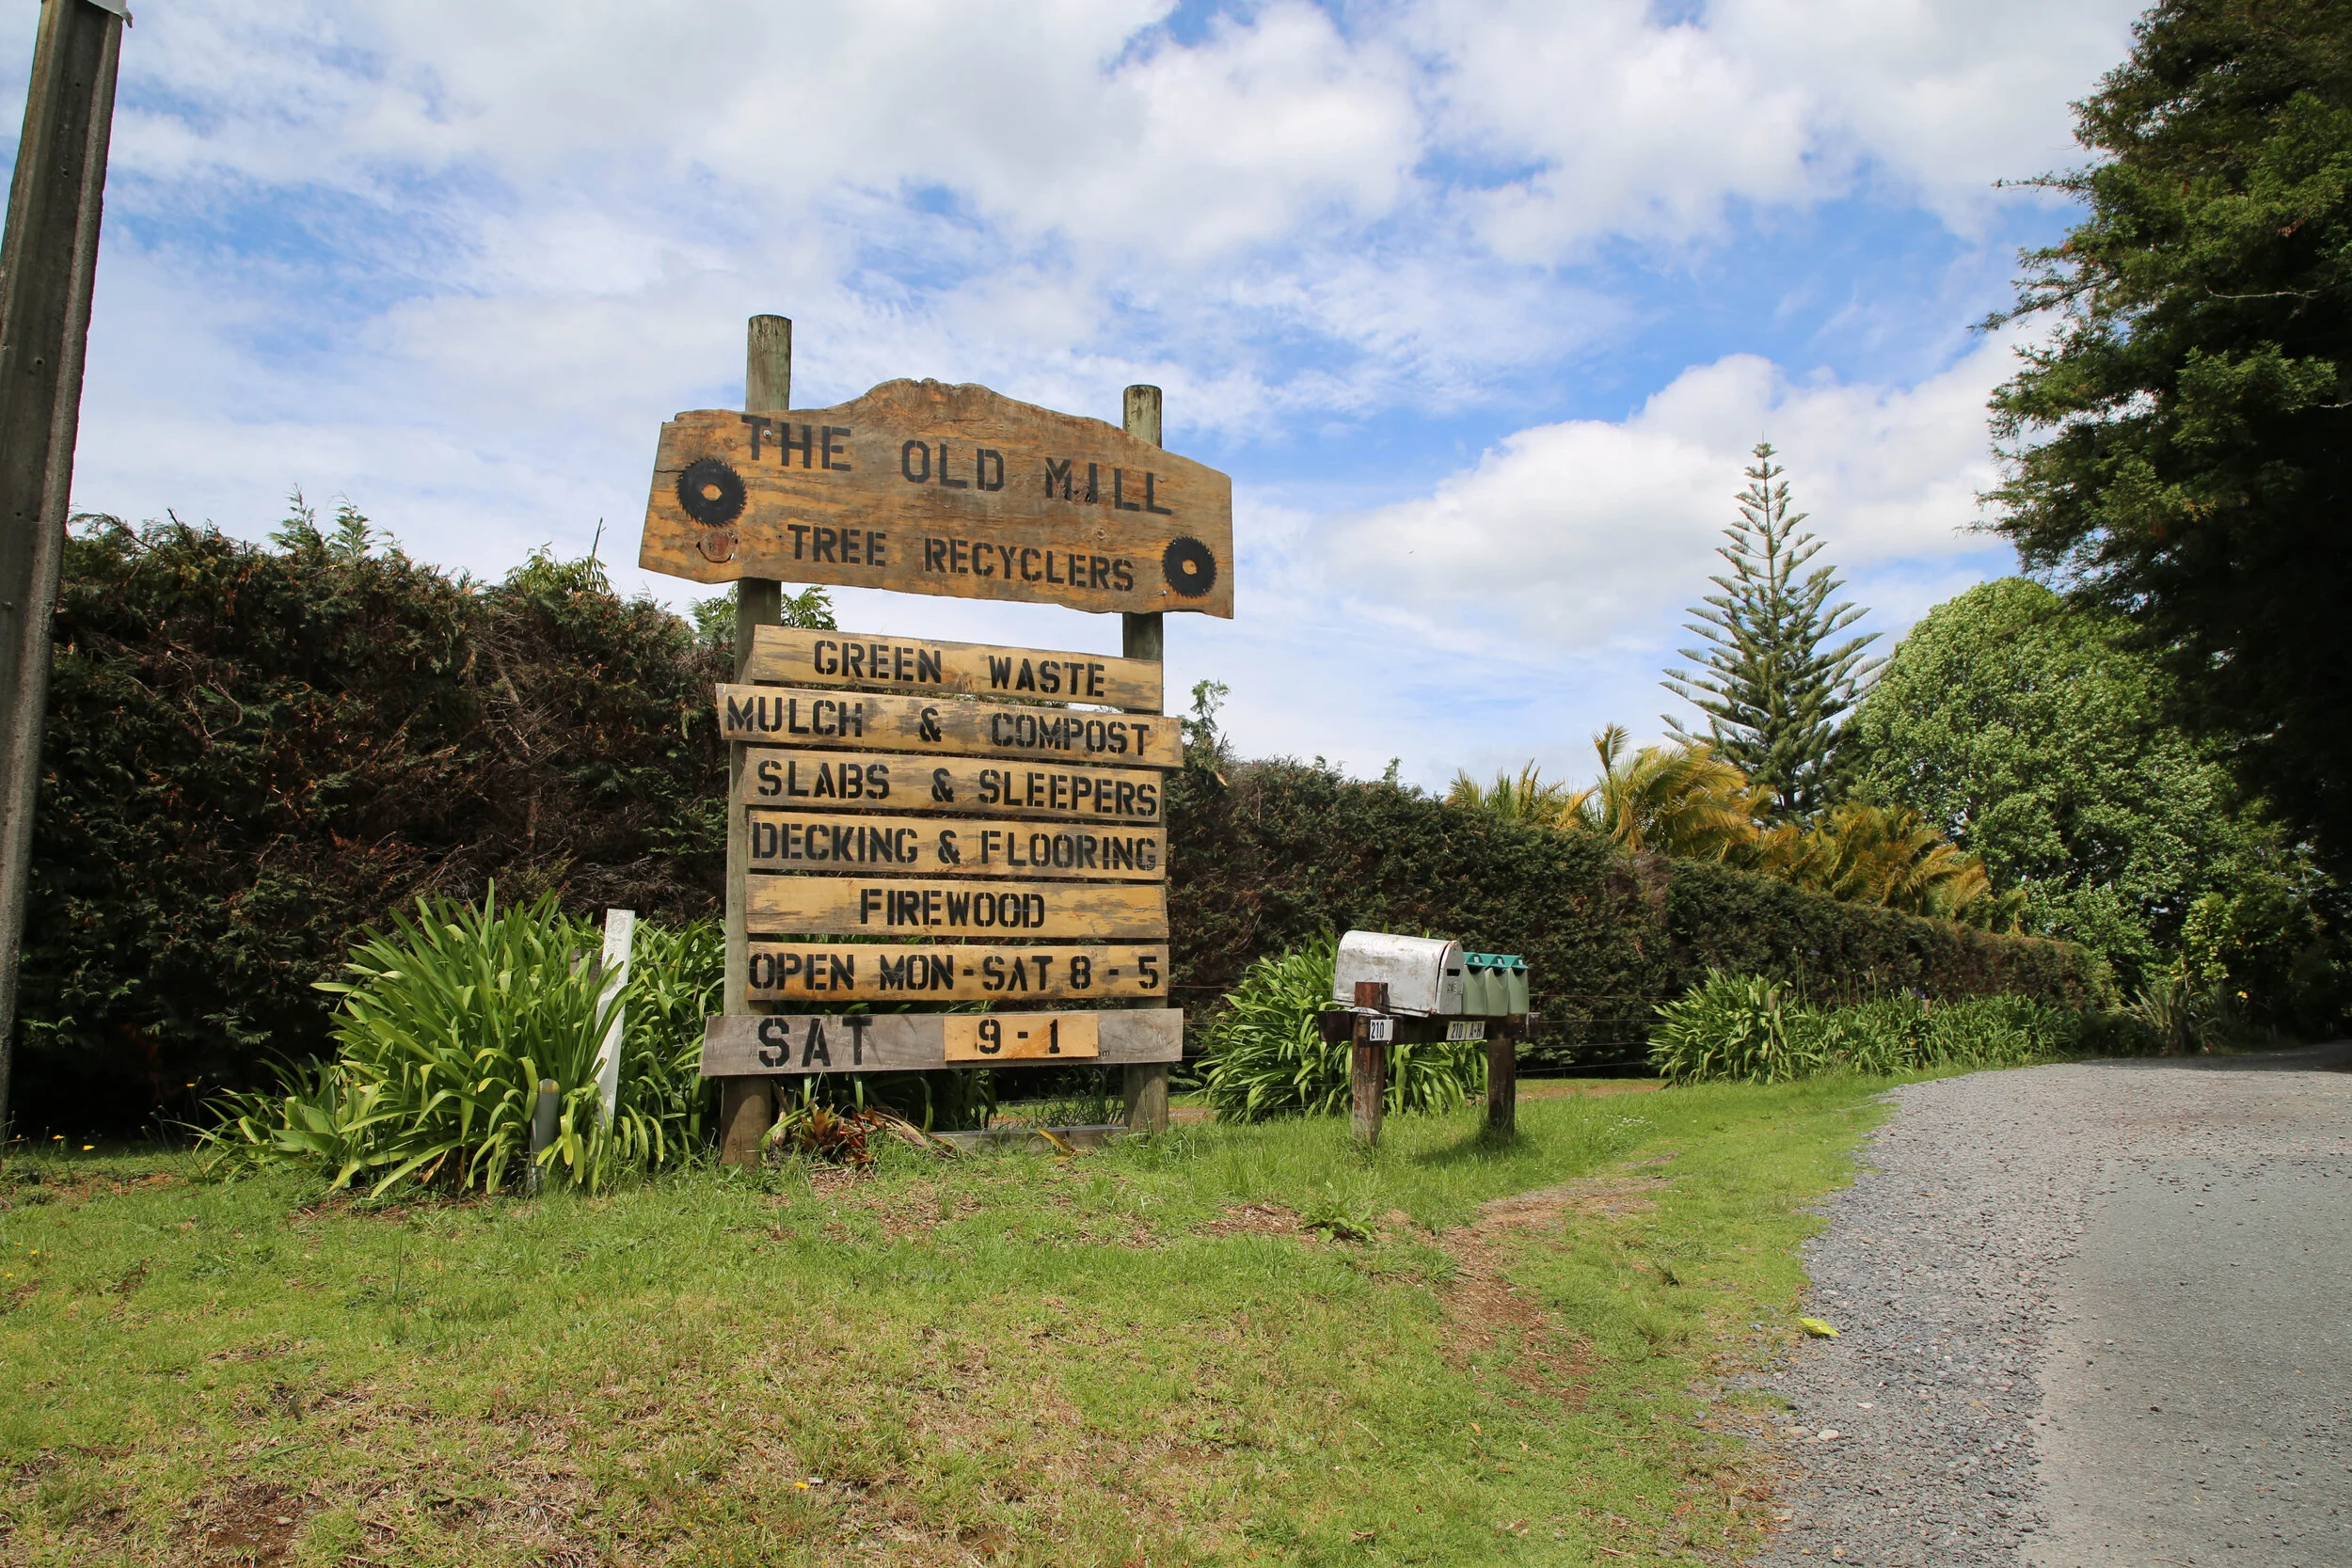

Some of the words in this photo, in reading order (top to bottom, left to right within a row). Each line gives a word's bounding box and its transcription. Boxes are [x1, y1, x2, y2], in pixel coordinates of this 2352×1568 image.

[740, 414, 851, 472] THE
[901, 439, 1005, 492] OLD
[1045, 457, 1172, 515] MILL
[787, 524, 886, 566] TREE
[925, 538, 1135, 592] RECYCLERS
[814, 640, 941, 684] GREEN
[989, 655, 1104, 697] WASTE
[727, 695, 863, 737] MULCH
[919, 707, 942, 742] &
[992, 713, 1150, 756] COMPOST
[758, 760, 890, 800] SLABS
[931, 768, 954, 803] &
[978, 769, 1157, 816] SLEEPERS
[753, 822, 917, 863] DECKING
[938, 830, 960, 864] &
[981, 830, 1156, 871] FLOORING
[860, 889, 1045, 928] FIREWOOD
[749, 953, 854, 990] OPEN
[880, 954, 1054, 991] MON-SAT
[758, 1017, 873, 1068] SAT
[1371, 1022, 1385, 1039] 210
[1451, 1023, 1464, 1039] 210
